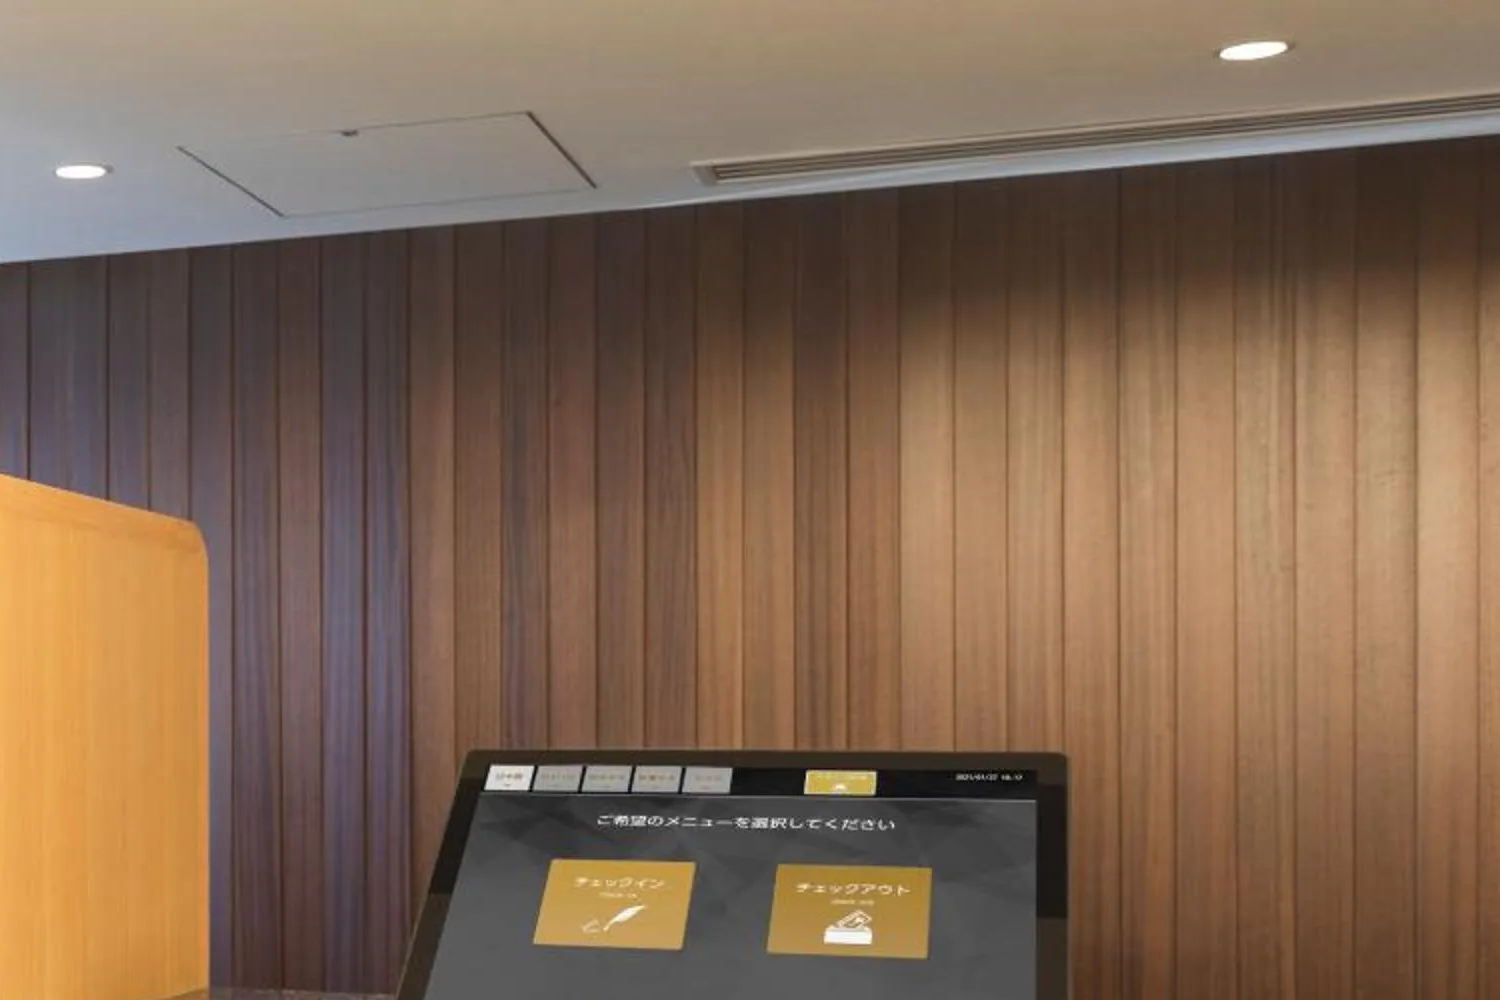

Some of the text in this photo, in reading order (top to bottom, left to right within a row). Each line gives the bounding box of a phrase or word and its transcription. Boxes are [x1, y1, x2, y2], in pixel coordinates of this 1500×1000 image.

[597, 814, 896, 832] ご希望のメニューを選択してください
[573, 876, 666, 891] チェックイン
[795, 882, 911, 896] チェックアウト
